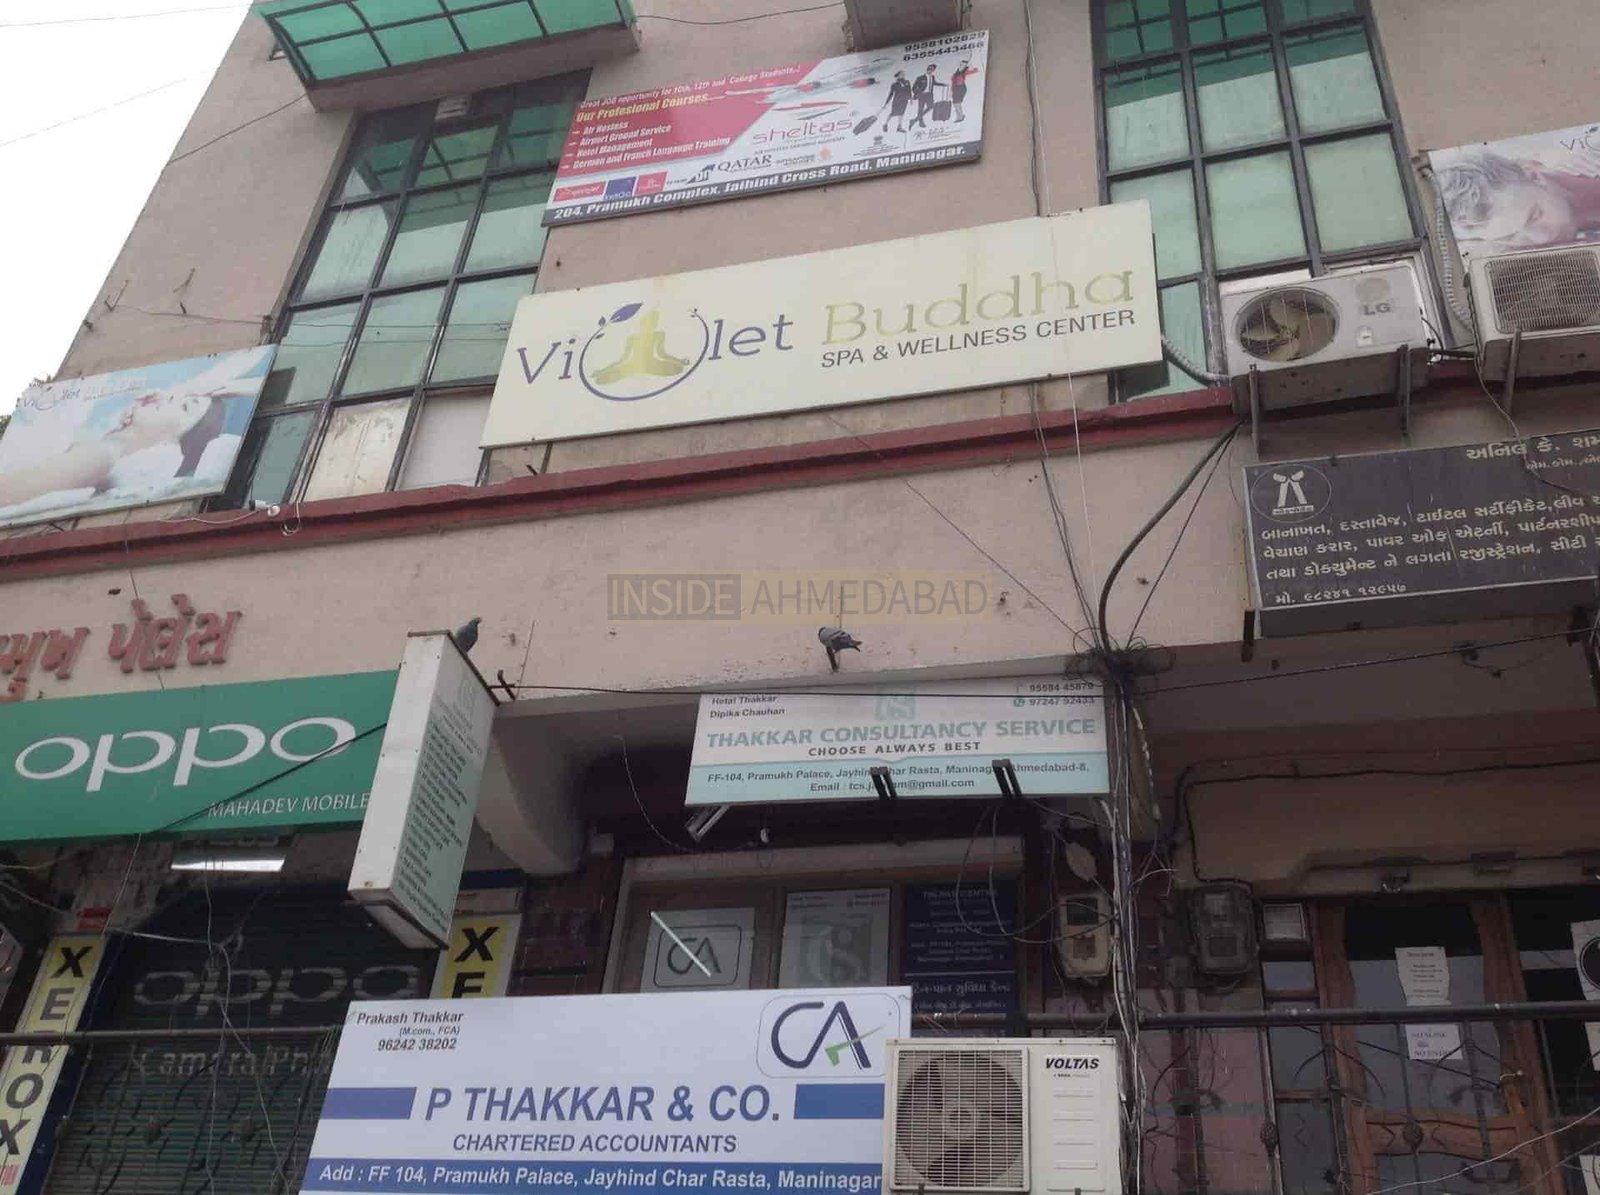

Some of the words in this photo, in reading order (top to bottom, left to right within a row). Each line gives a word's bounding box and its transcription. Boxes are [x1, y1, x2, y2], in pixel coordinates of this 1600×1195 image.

[576, 111, 596, 122] Our
[640, 124, 672, 136] Service
[752, 119, 853, 144] sheltas
[718, 154, 772, 172] QATAR
[586, 197, 651, 214] Pramukh
[782, 168, 827, 183] Cross
[822, 269, 1134, 345] Buddha
[1363, 302, 1391, 316] LG
[821, 348, 864, 368] SPA
[873, 344, 889, 361] &
[897, 324, 1027, 358] WELLNESS
[1036, 309, 1136, 338] CENTER
[1266, 567, 1296, 580] તથા
[739, 694, 778, 705] Thakkar
[709, 709, 740, 719] Dipika
[742, 706, 786, 718] Chauhan
[706, 729, 813, 748] THAKKAR
[820, 720, 987, 743] CONSULTANCY
[996, 718, 1097, 737] SERVICE
[15, 716, 357, 792] oppo
[808, 745, 867, 757] CHOOSE
[874, 742, 936, 754] ALWAYS
[944, 741, 982, 751] BEST
[747, 771, 794, 782] Pramukh
[835, 767, 871, 781] Jayhin
[810, 782, 840, 793] Email
[207, 797, 300, 819] MAHADEV
[667, 937, 721, 975] CA
[356, 1011, 408, 1025] Prakash
[412, 1011, 464, 1024] Thakkar
[377, 1039, 415, 1051] 96242
[418, 1037, 457, 1050] 38202
[771, 1001, 872, 1070] CA
[1045, 1058, 1100, 1070] VOLTAS
[425, 1087, 452, 1121] P
[464, 1085, 655, 1121] THAKKAR
[667, 1085, 694, 1122] &
[709, 1084, 779, 1121] CO.
[453, 1134, 575, 1152] CHARTERED
[579, 1134, 737, 1152] ACCOUNTANTS
[319, 1164, 353, 1181] Add
[368, 1165, 391, 1182] FF
[396, 1165, 427, 1186] 104,
[433, 1166, 510, 1185] Pramukh
[515, 1166, 578, 1188] Palace,
[584, 1167, 656, 1189] Jayhind
[662, 1169, 707, 1188] Char
[712, 1170, 771, 1190] Rasta,
[778, 1170, 882, 1194] Maninagar
